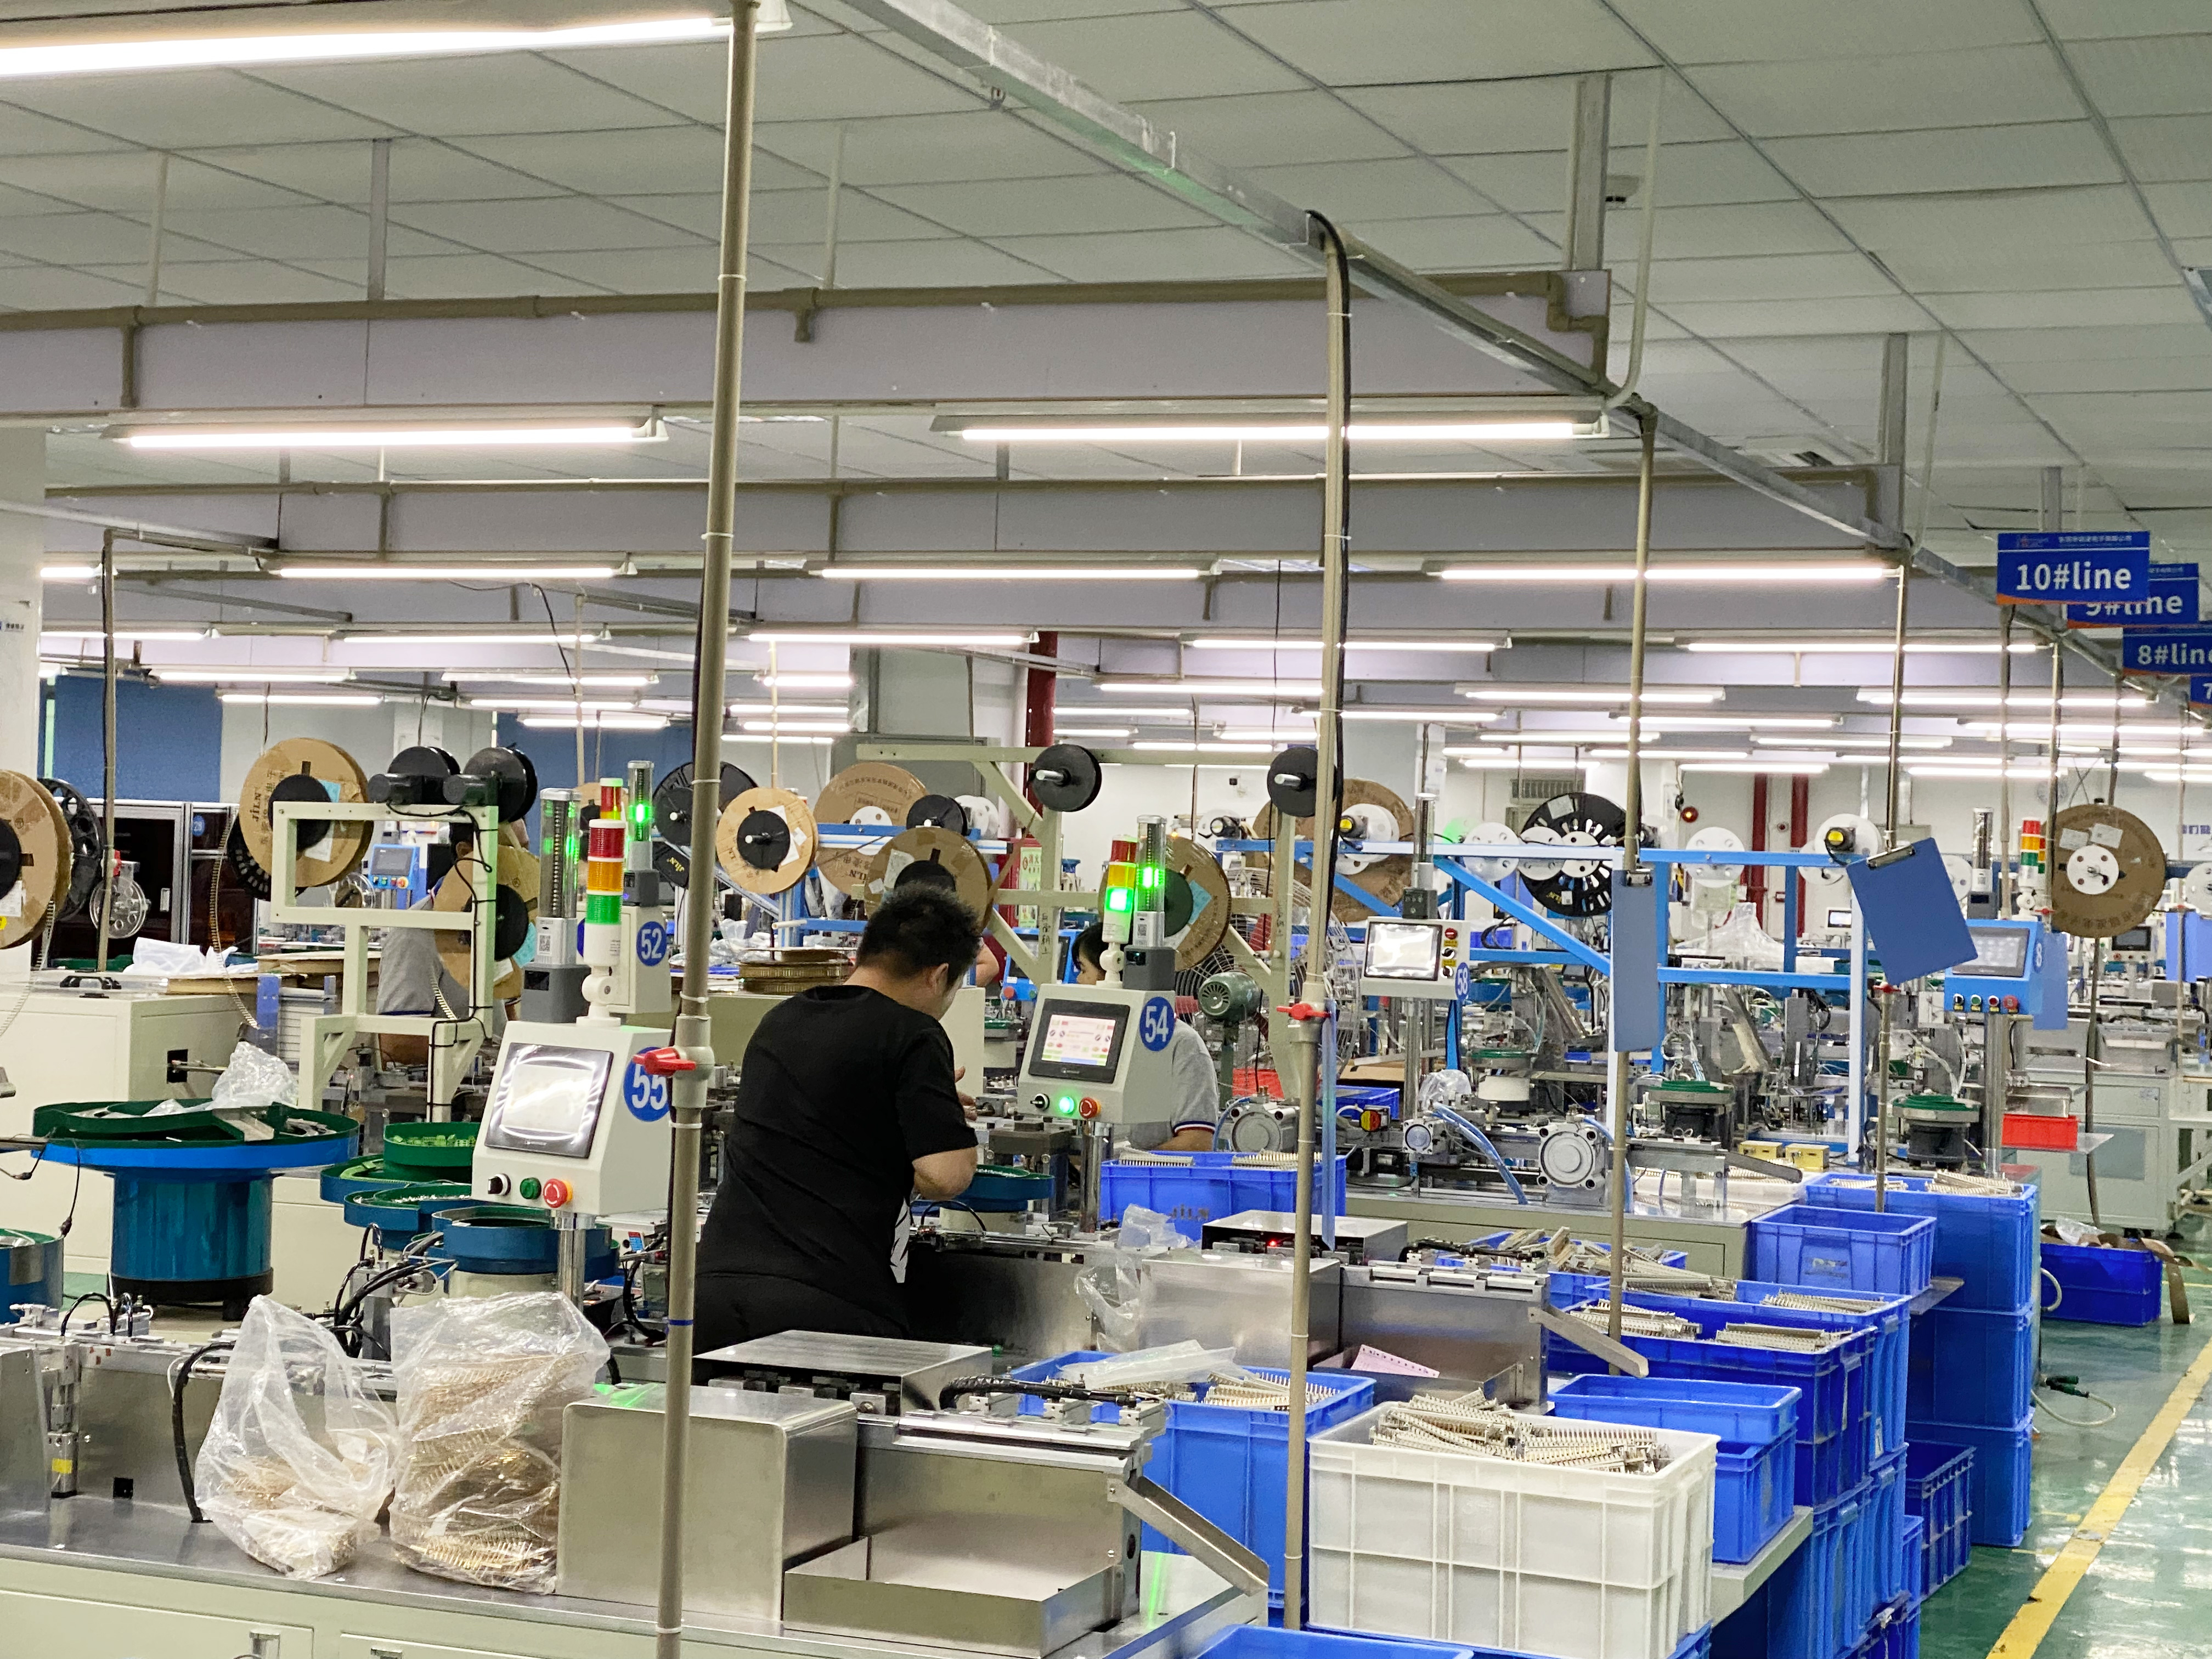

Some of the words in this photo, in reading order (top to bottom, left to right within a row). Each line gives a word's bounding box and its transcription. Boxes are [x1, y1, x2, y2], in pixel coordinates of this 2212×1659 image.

[2016, 561, 2132, 591] 10#line
[2137, 642, 2212, 665] 8#lin
[640, 927, 663, 960] 52
[1457, 967, 1469, 996] 58
[1144, 1005, 1169, 1043] 54
[631, 1062, 667, 1110] 55
